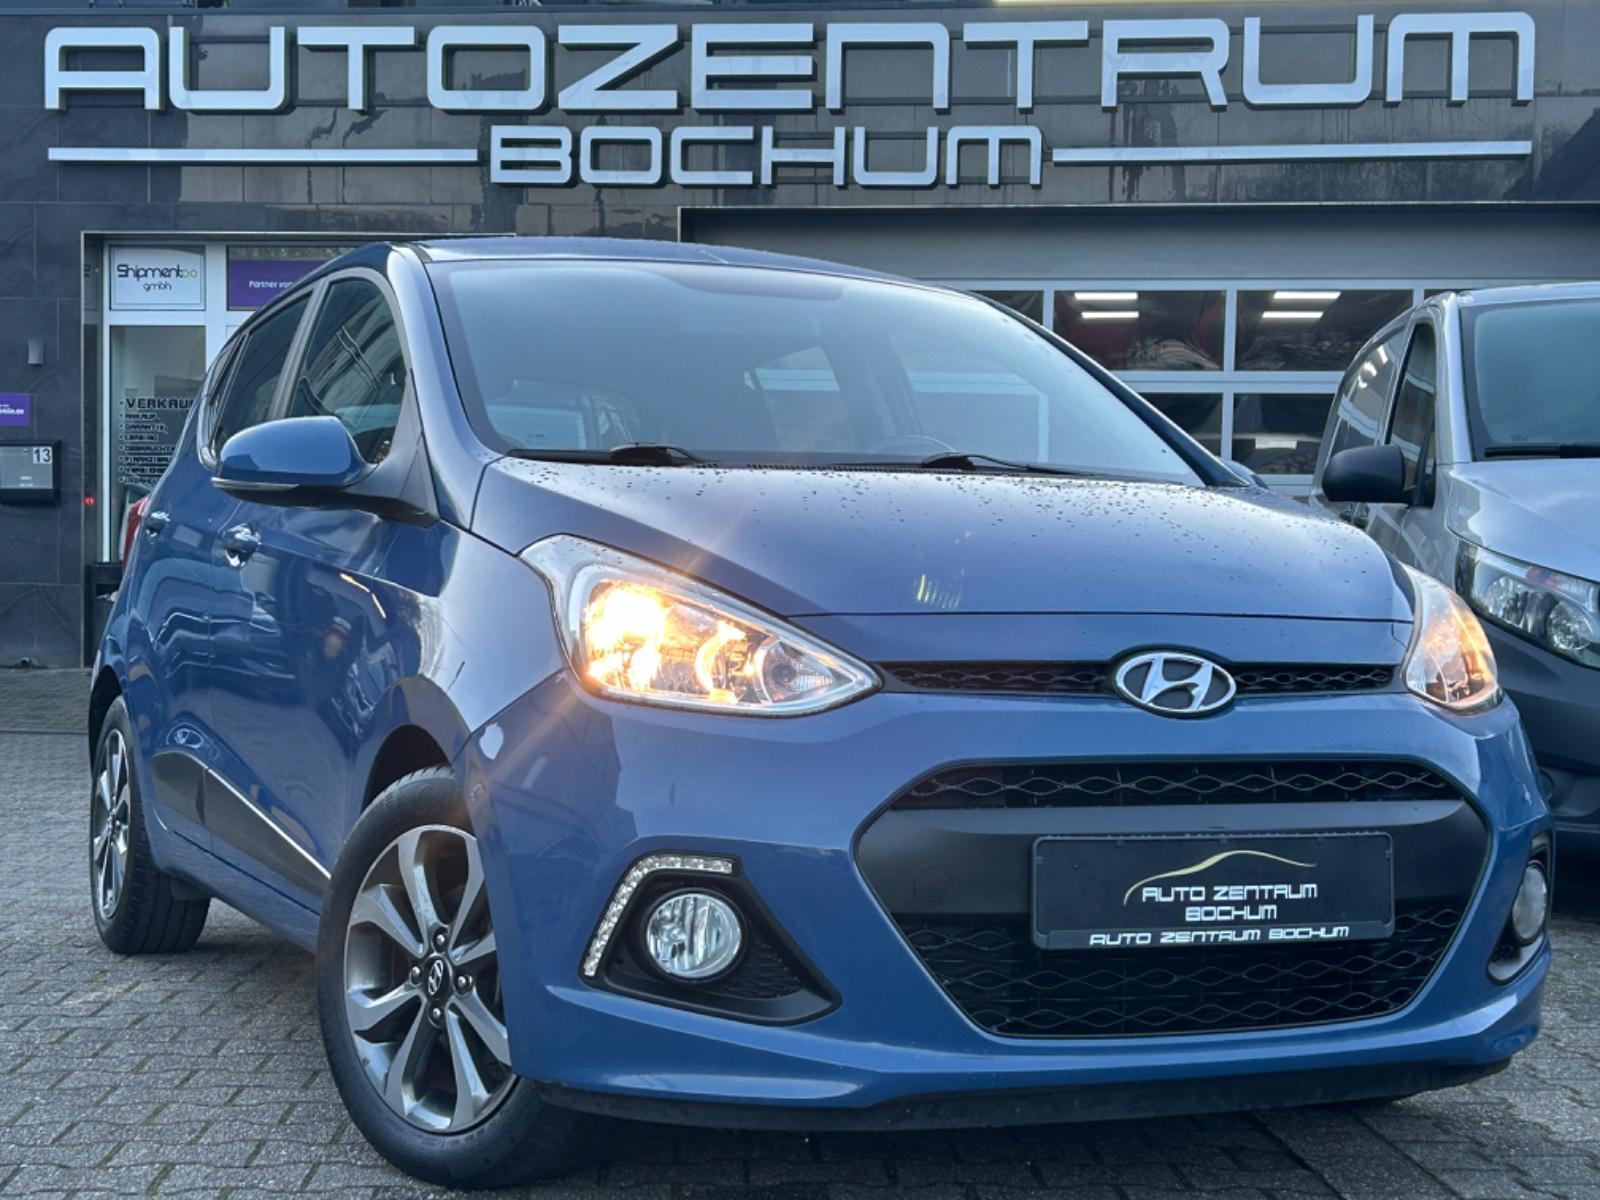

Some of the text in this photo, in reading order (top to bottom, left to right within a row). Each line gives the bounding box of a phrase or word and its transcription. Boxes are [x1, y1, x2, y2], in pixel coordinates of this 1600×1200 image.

[44, 11, 1535, 112] AUTOZENTRUM
[490, 124, 1043, 188] BOCHUM
[34, 448, 51, 463] 13
[1142, 883, 1318, 903] AUTO ZENTRUM
[1185, 904, 1278, 922] BOCHUM
[1089, 926, 1350, 946] AUTO ZENTRUM BOCHUM
